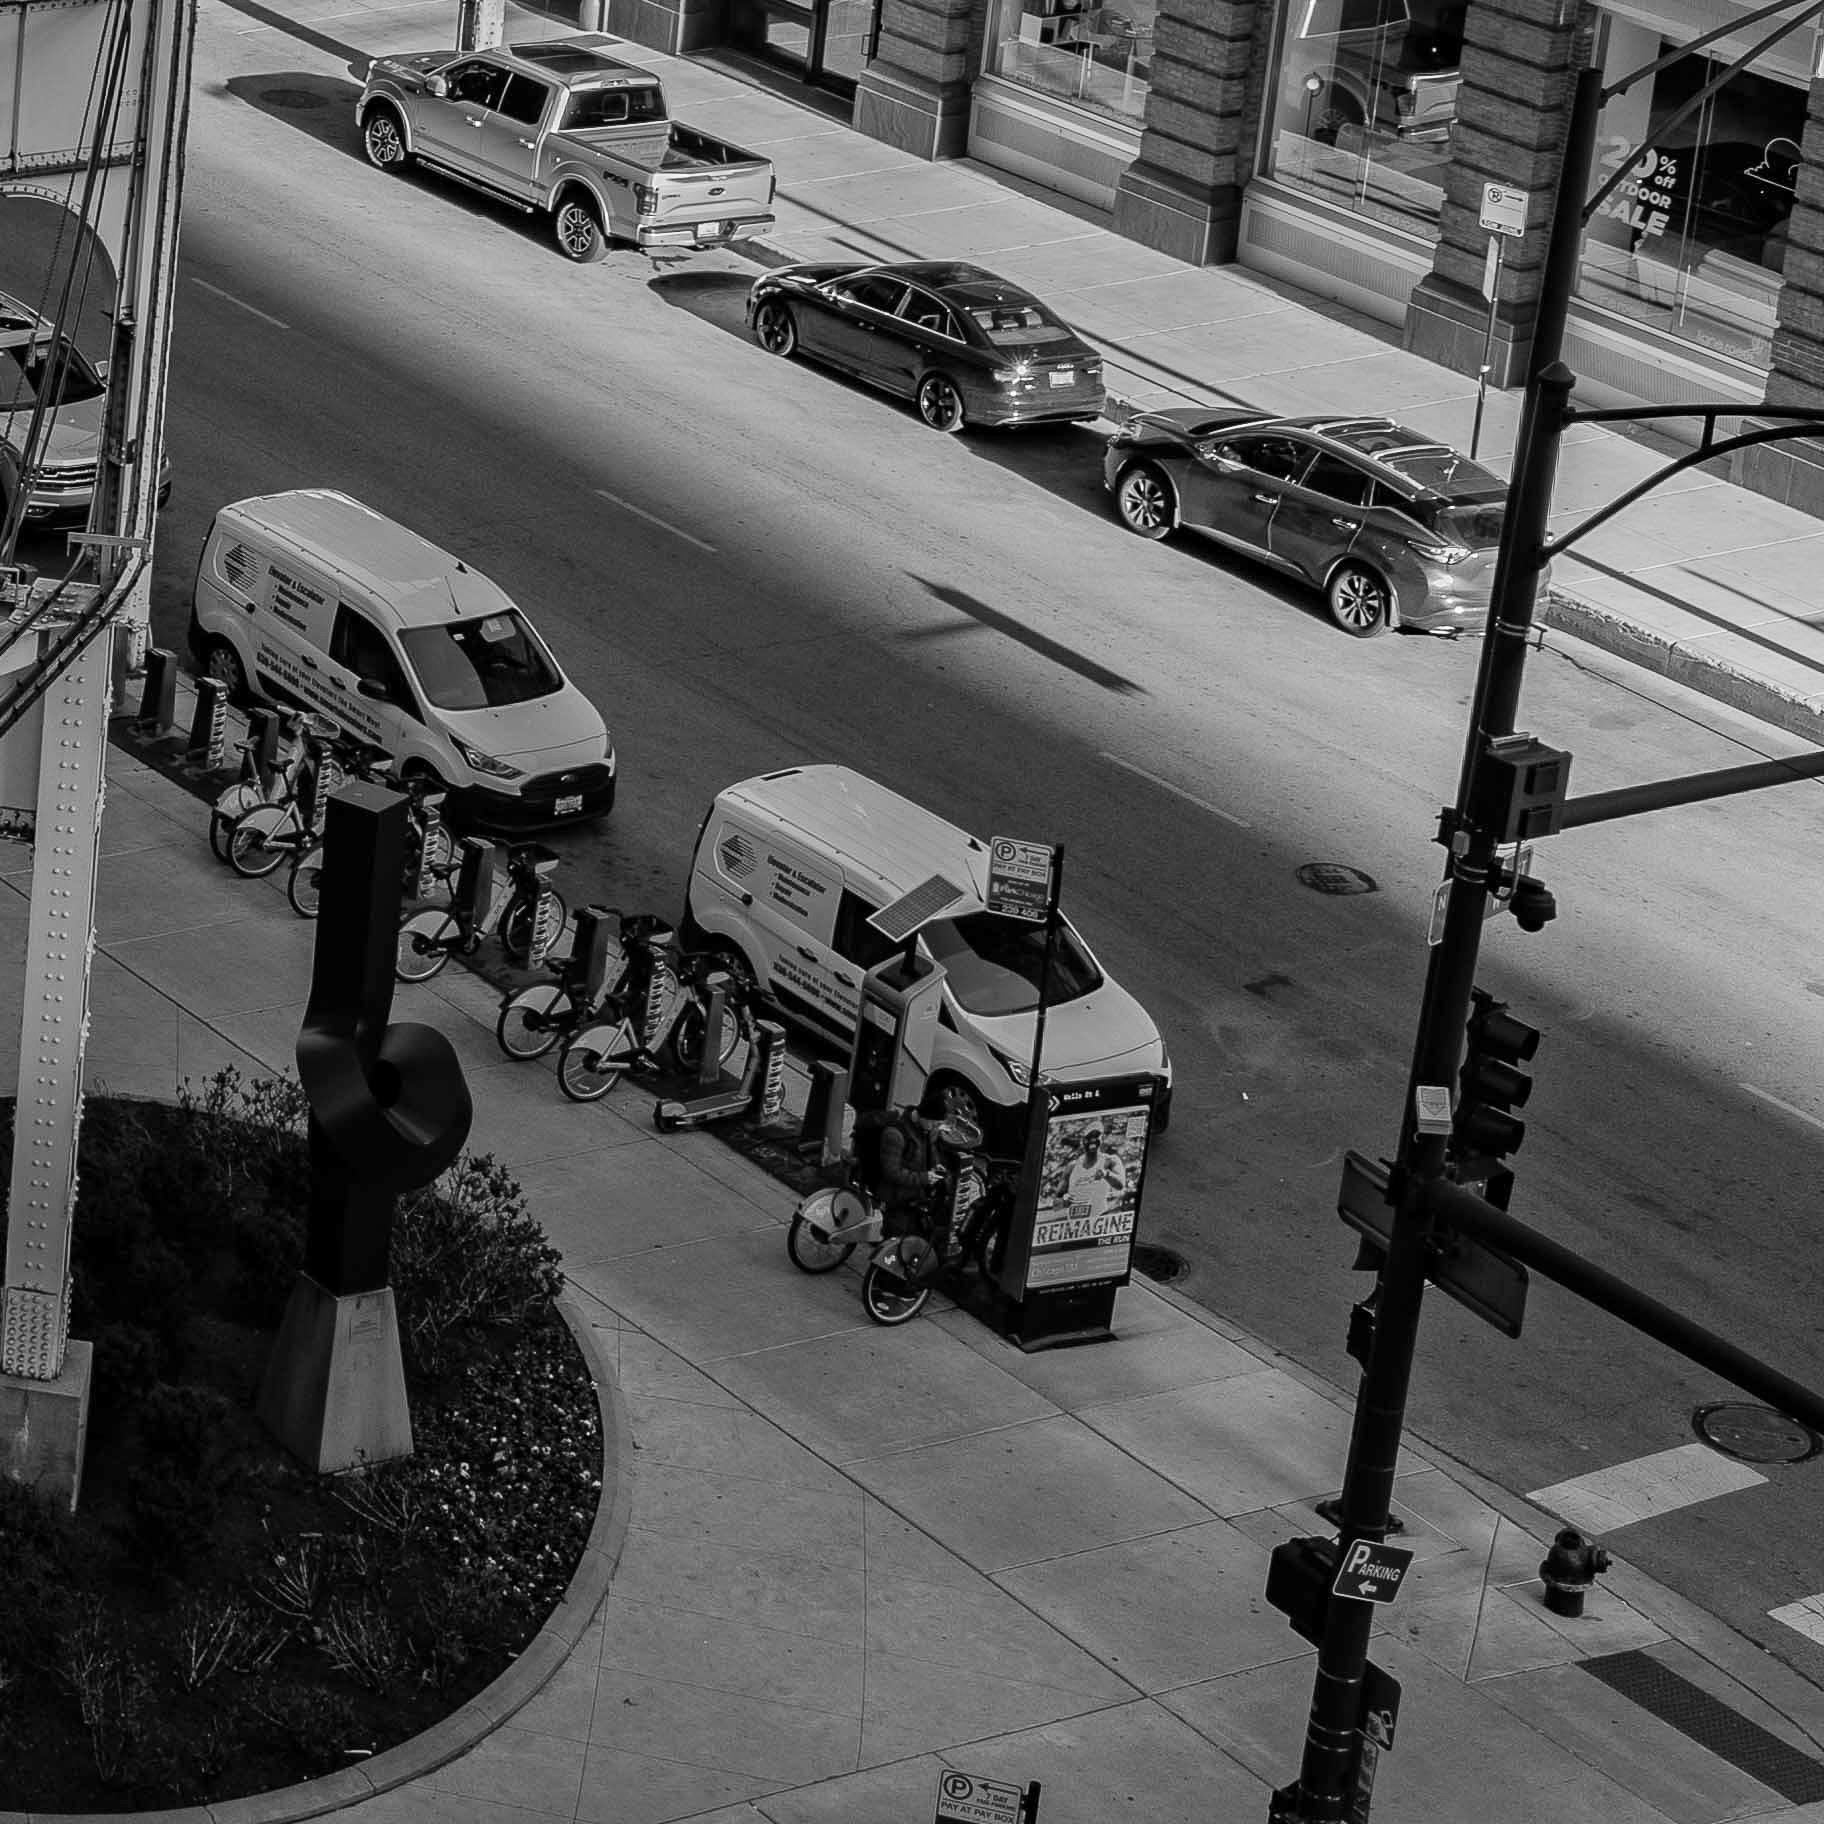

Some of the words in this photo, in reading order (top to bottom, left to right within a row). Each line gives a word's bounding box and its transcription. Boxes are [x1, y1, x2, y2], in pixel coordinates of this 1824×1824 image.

[1654, 175, 1677, 190] off
[1036, 1213, 1132, 1245] REIMAGINE
[1347, 1544, 1401, 1582] PARKING
[940, 1800, 959, 1812] PAY
[974, 1808, 992, 1819] PAY
[994, 1813, 1015, 1824] BOX
